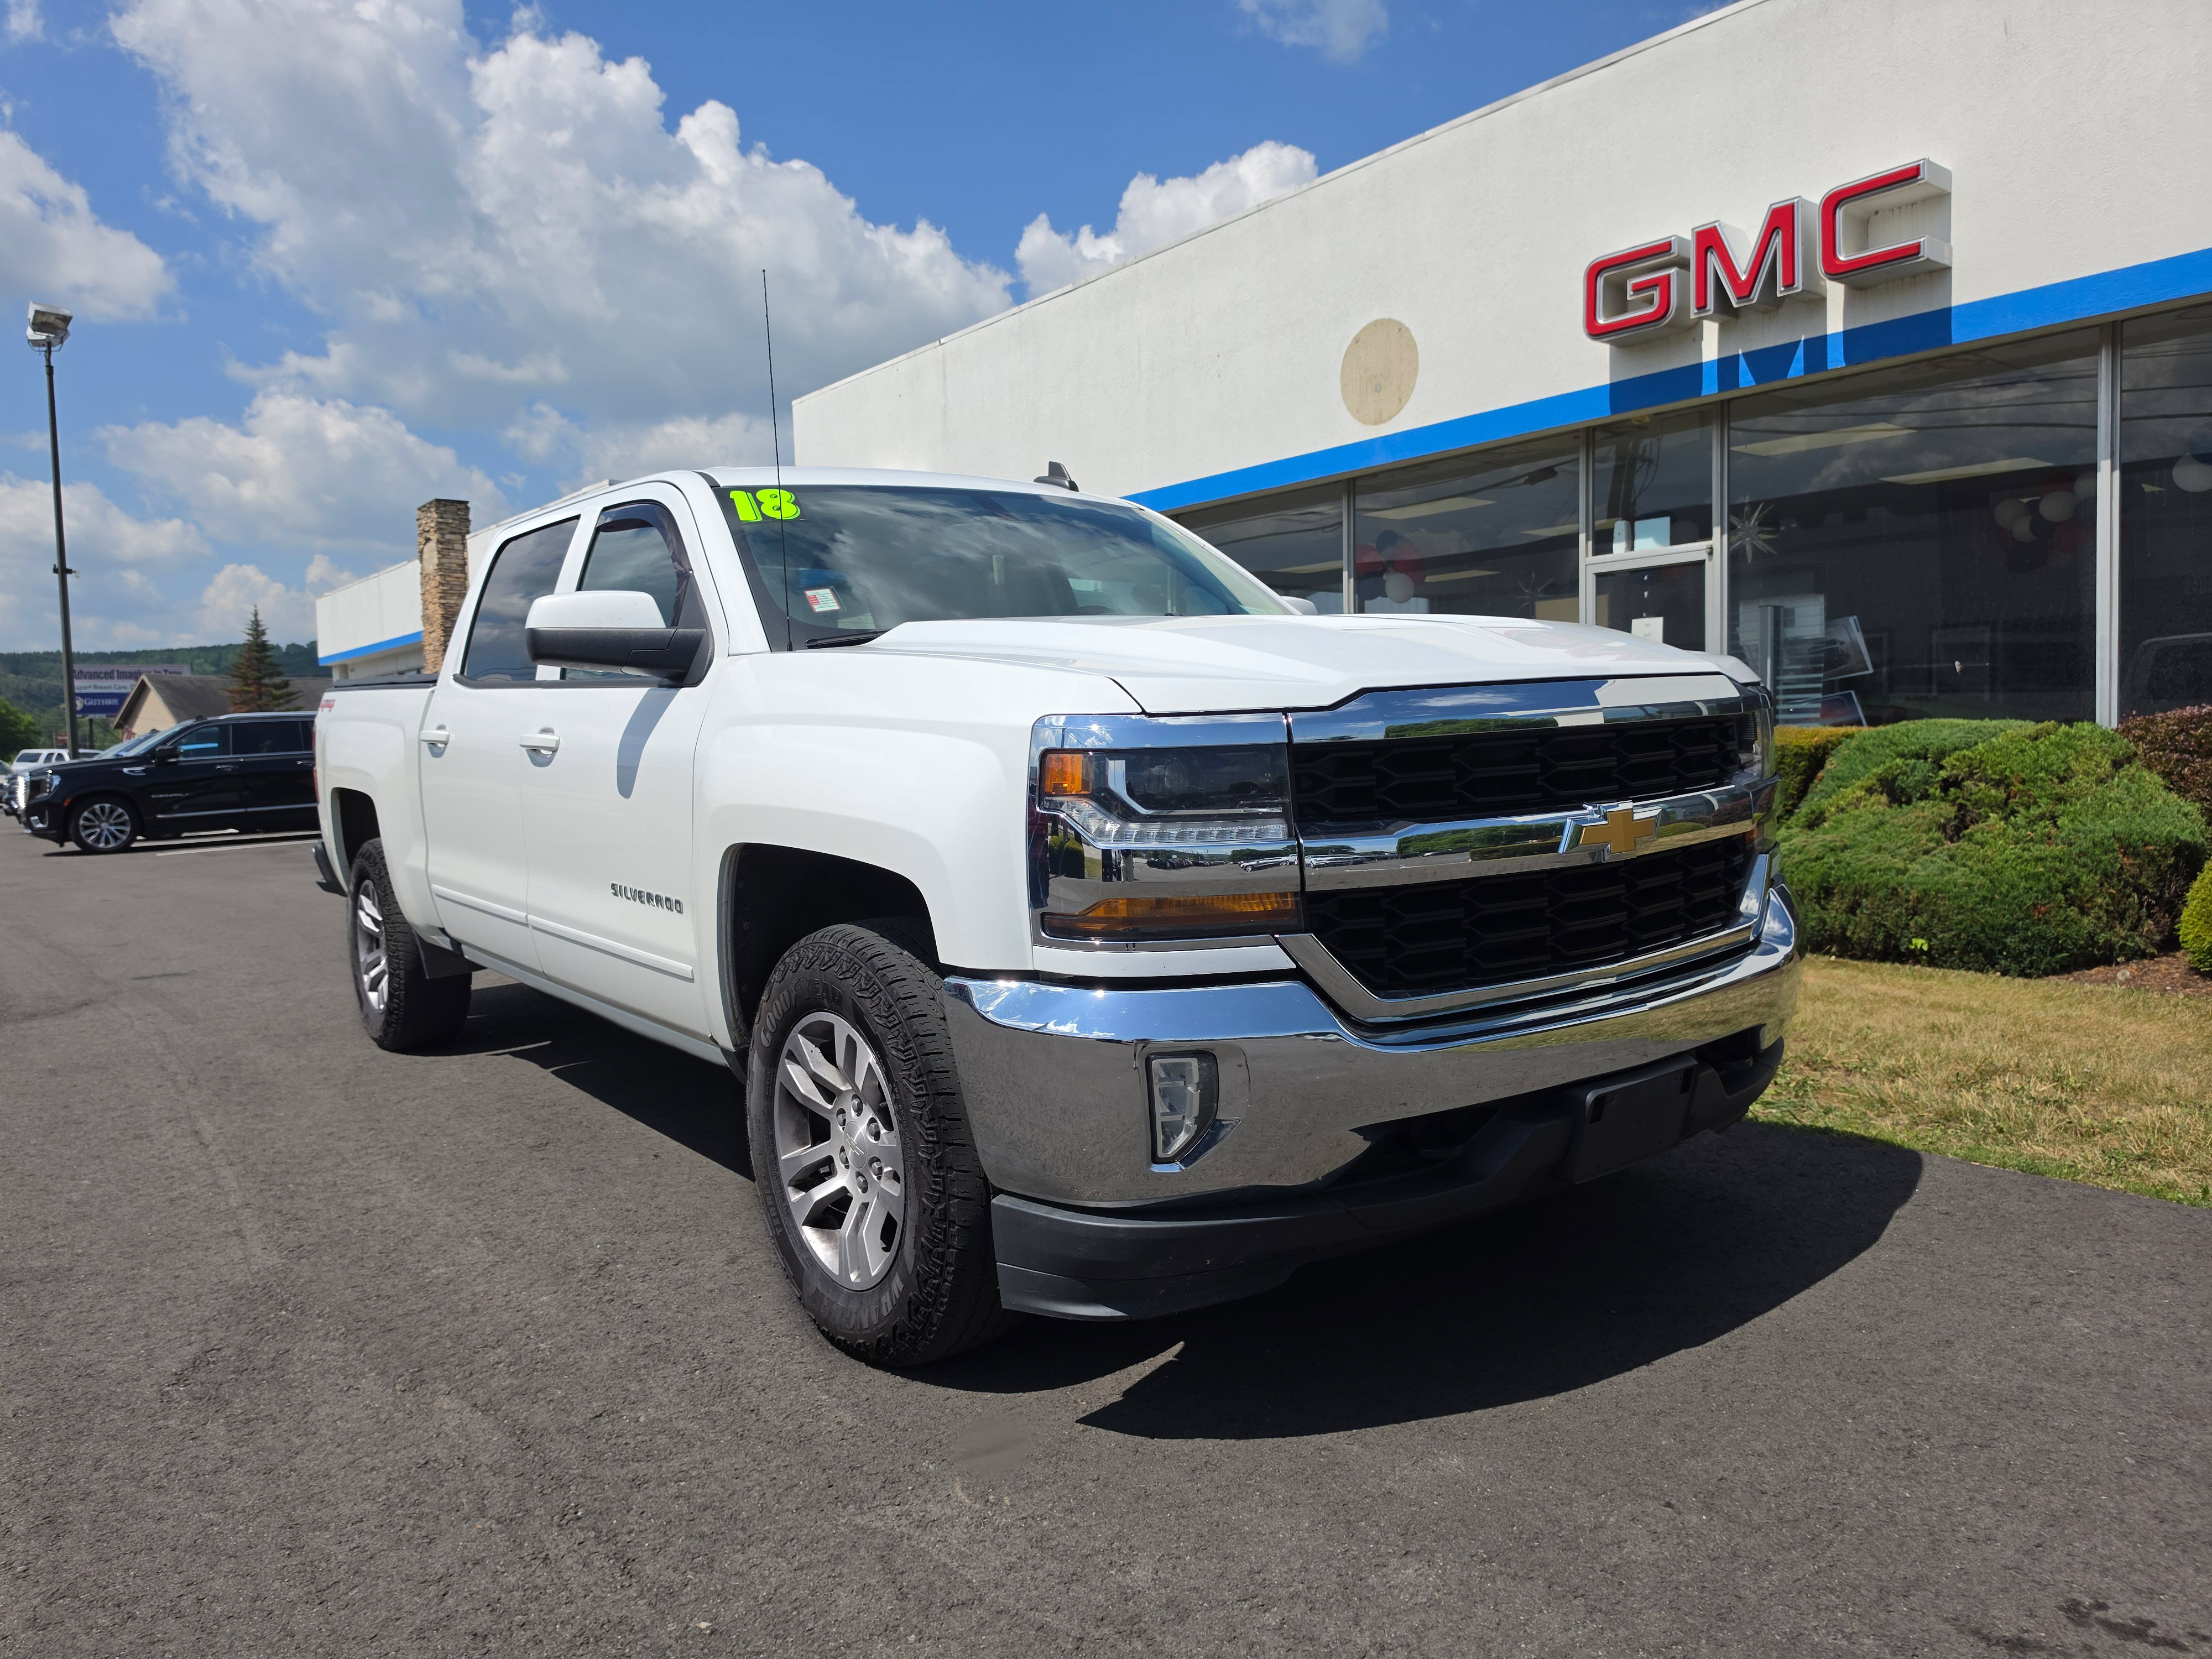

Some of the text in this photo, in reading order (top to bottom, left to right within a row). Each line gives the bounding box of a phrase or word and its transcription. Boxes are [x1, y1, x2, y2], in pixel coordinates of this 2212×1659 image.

[1584, 158, 1950, 343] GMC
[730, 489, 801, 522] 18
[611, 883, 683, 914] SILVERADO
